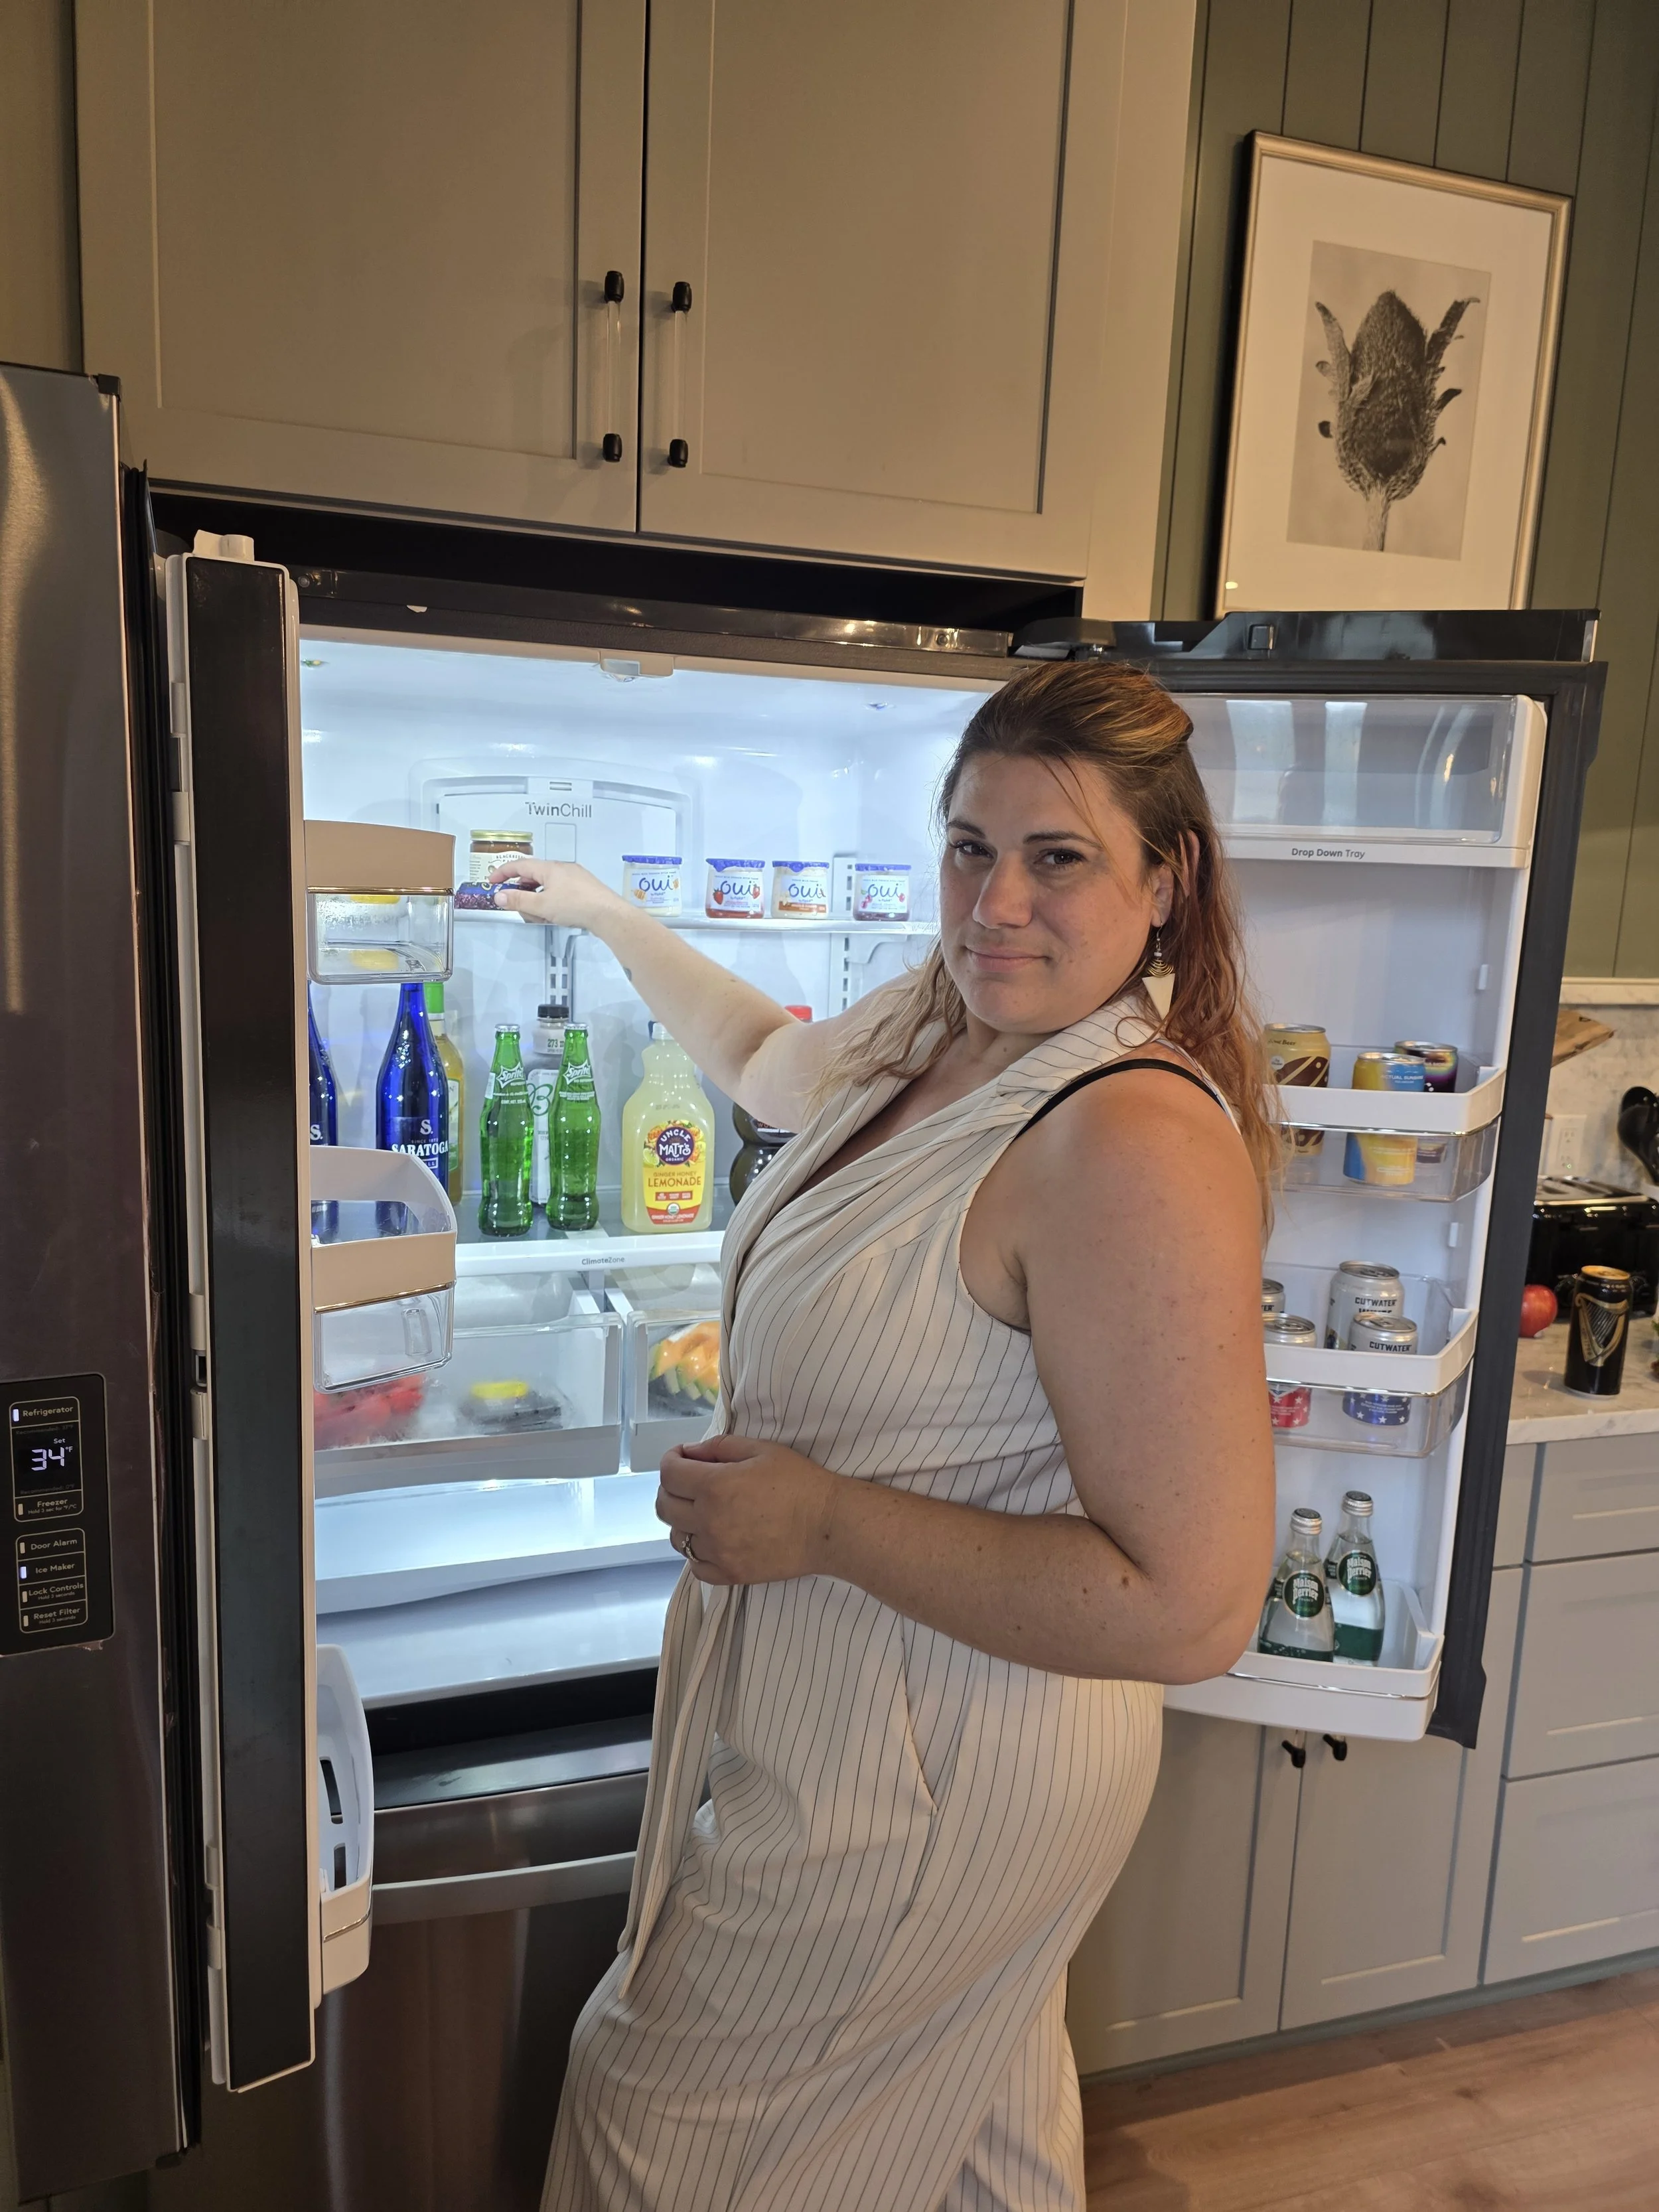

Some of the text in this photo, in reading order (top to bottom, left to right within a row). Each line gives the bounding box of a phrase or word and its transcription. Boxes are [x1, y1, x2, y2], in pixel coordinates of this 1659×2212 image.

[525, 802, 592, 818] TwinChill
[1291, 848, 1314, 857] Drop
[1345, 849, 1365, 859] Tray
[547, 1038, 557, 1047] 273
[660, 1129, 691, 1142] UNCLE
[392, 1140, 449, 1157] SARATOGA
[659, 1143, 691, 1157] MATT'S
[648, 1176, 701, 1187] LEMONADE
[1355, 1297, 1395, 1307] CUTWATER
[1370, 1341, 1409, 1351] CUTWATER
[23, 1407, 74, 1416] Refrigerator
[37, 1499, 68, 1508] Freezer
[1347, 1557, 1371, 1570] Maison
[1347, 1566, 1372, 1584] Perrier
[49, 1582, 84, 1593] Controls
[1293, 1578, 1318, 1592] Maison
[1293, 1587, 1319, 1605] Perrier
